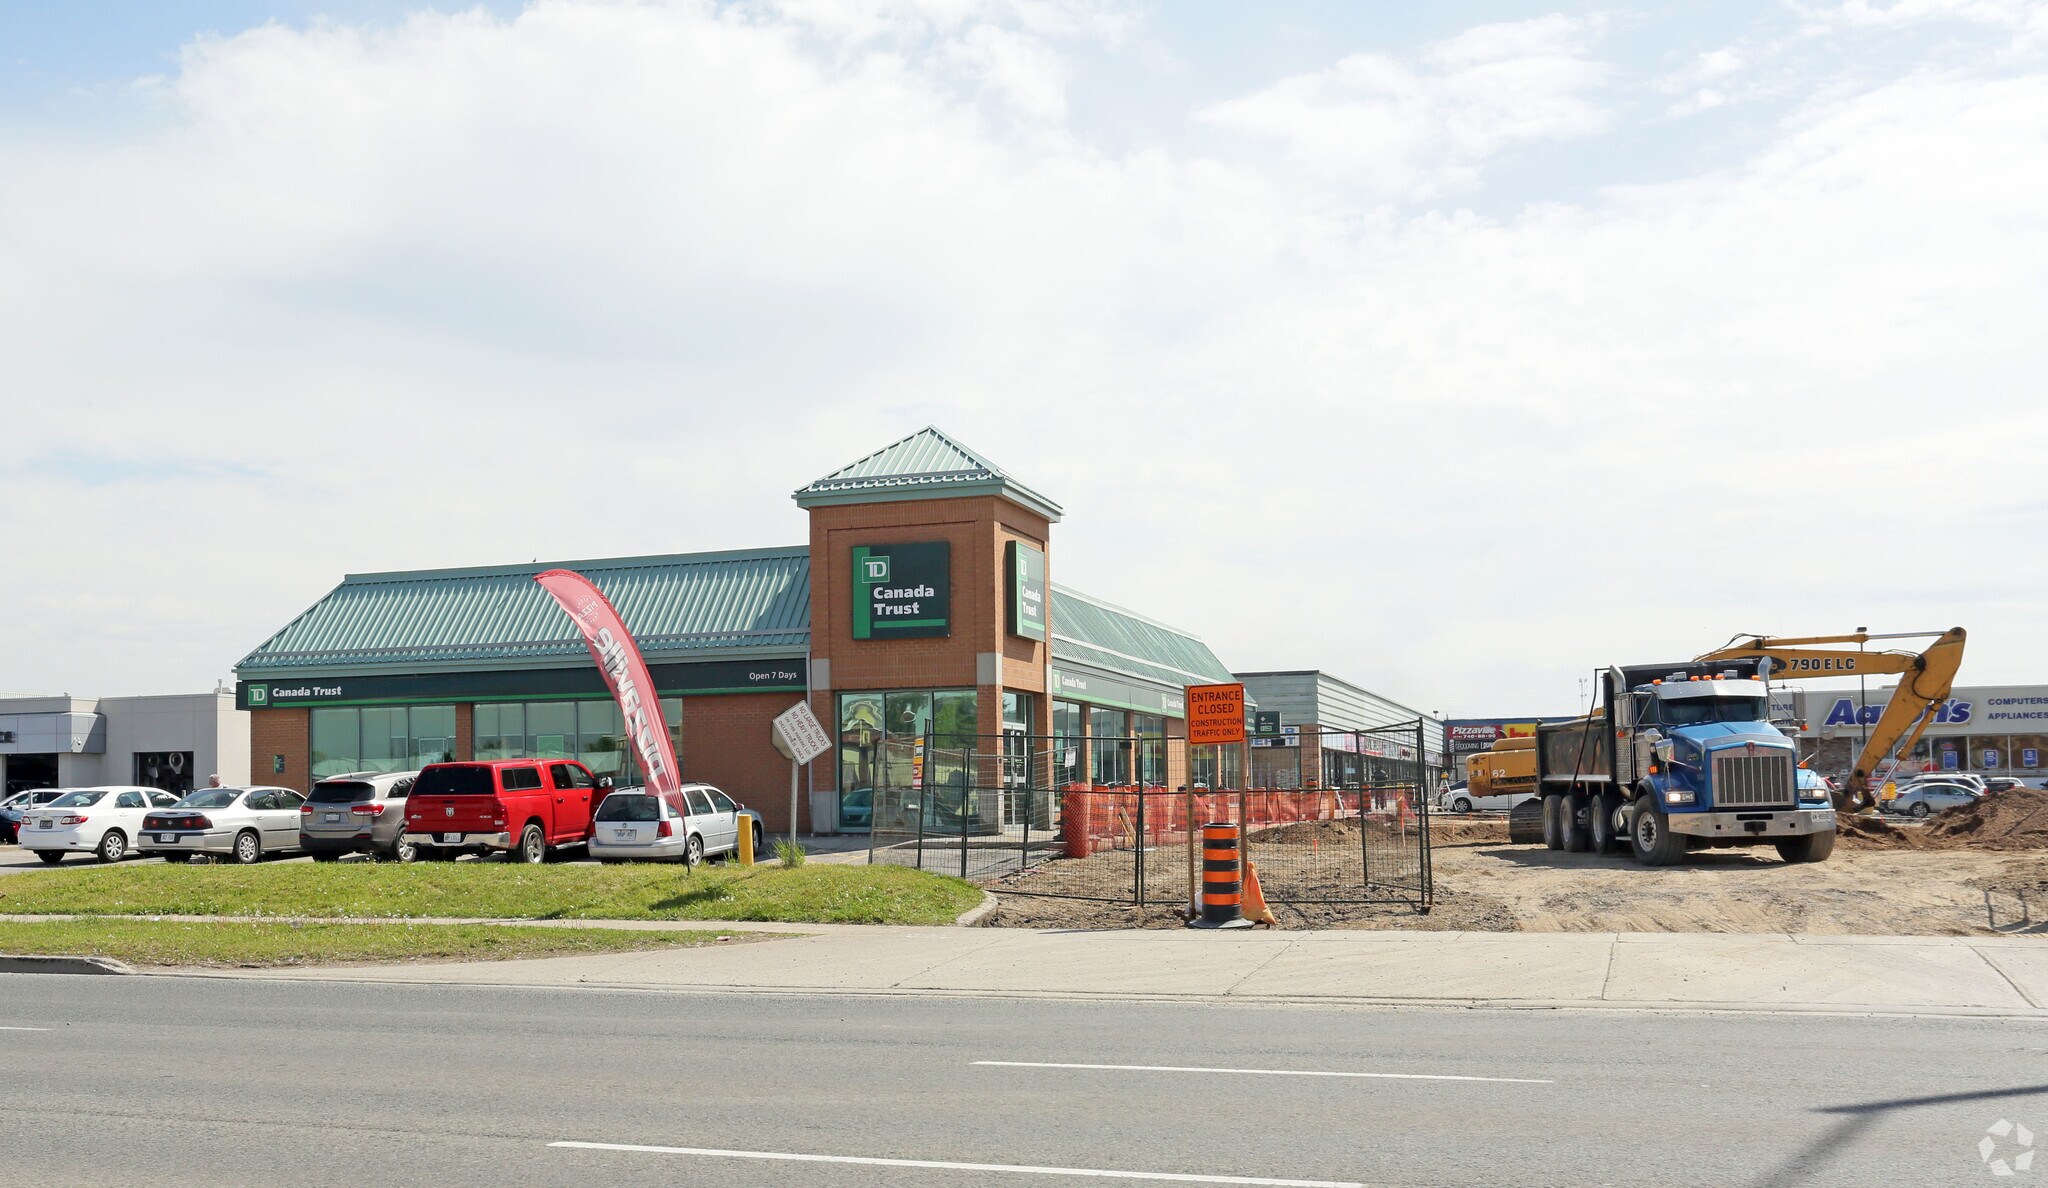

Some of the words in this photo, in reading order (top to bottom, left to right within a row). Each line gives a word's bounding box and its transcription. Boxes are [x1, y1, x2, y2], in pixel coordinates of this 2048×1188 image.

[864, 561, 887, 578] TD
[873, 584, 935, 600] Canada
[1022, 585, 1041, 603] Canada
[873, 602, 920, 616] Trust
[1022, 601, 1037, 617] Trust
[749, 672, 770, 681] Open
[771, 671, 777, 679] 7
[778, 671, 797, 681] Days
[1061, 675, 1076, 689] Canada
[1076, 678, 1087, 690] Trust
[250, 688, 266, 702] TD
[272, 687, 311, 697] Canada
[313, 686, 342, 696] Trust
[1191, 690, 1241, 703] ENTRANCE
[1197, 703, 1235, 715] CLOSED
[799, 705, 807, 714] NO
[803, 713, 816, 729] LARGE
[813, 728, 828, 747] TRUCKS
[1191, 718, 1242, 728] CONSTRUCTION
[791, 711, 799, 720] NO
[795, 719, 807, 734] HEAVY
[805, 733, 820, 752] TRUCKS
[1192, 728, 1221, 738] TRAFFIC
[1222, 728, 1240, 736] ONLY
[1452, 726, 1496, 735] Pizzaville
[1492, 769, 1506, 778] 62
